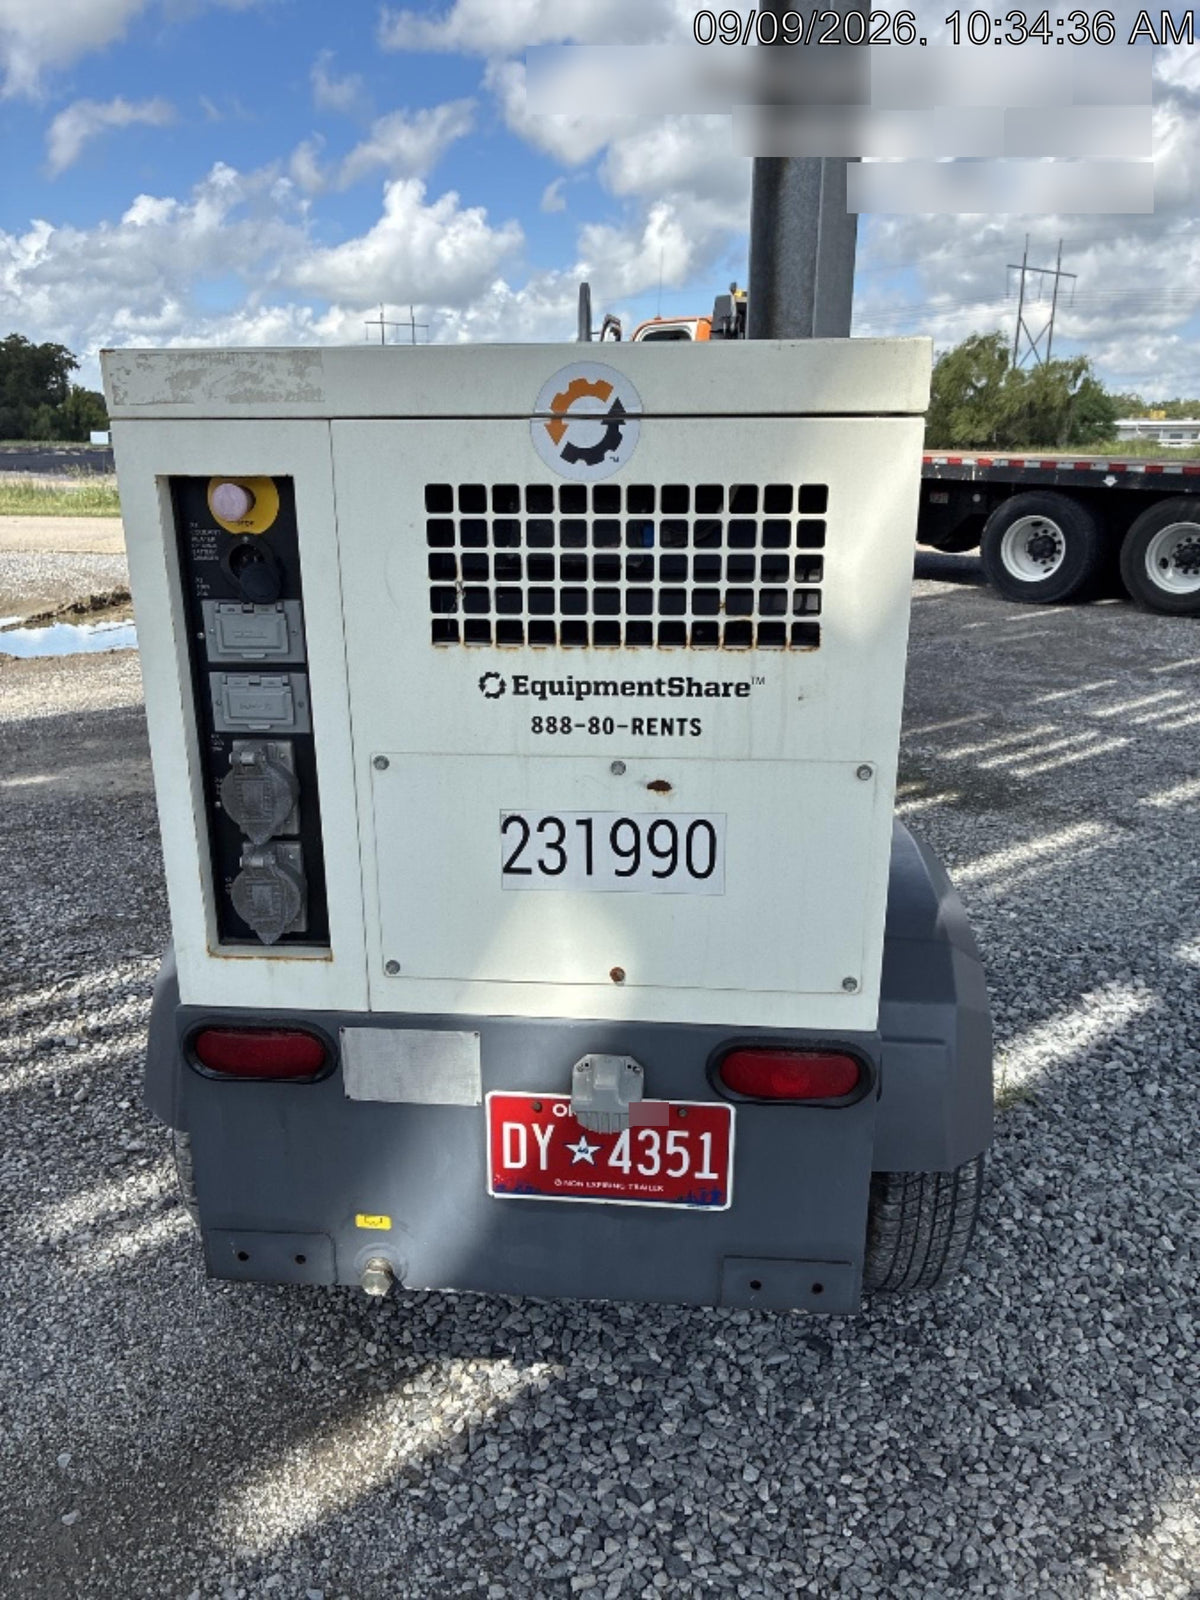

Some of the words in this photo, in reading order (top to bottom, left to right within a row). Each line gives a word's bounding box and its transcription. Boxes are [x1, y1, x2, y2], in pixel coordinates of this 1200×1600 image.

[511, 674, 751, 701] EquipmentShare
[531, 715, 702, 737] 888-80-RENTS
[500, 814, 718, 880] 231990
[502, 1121, 556, 1171] DY
[607, 1127, 719, 1180] 4351
